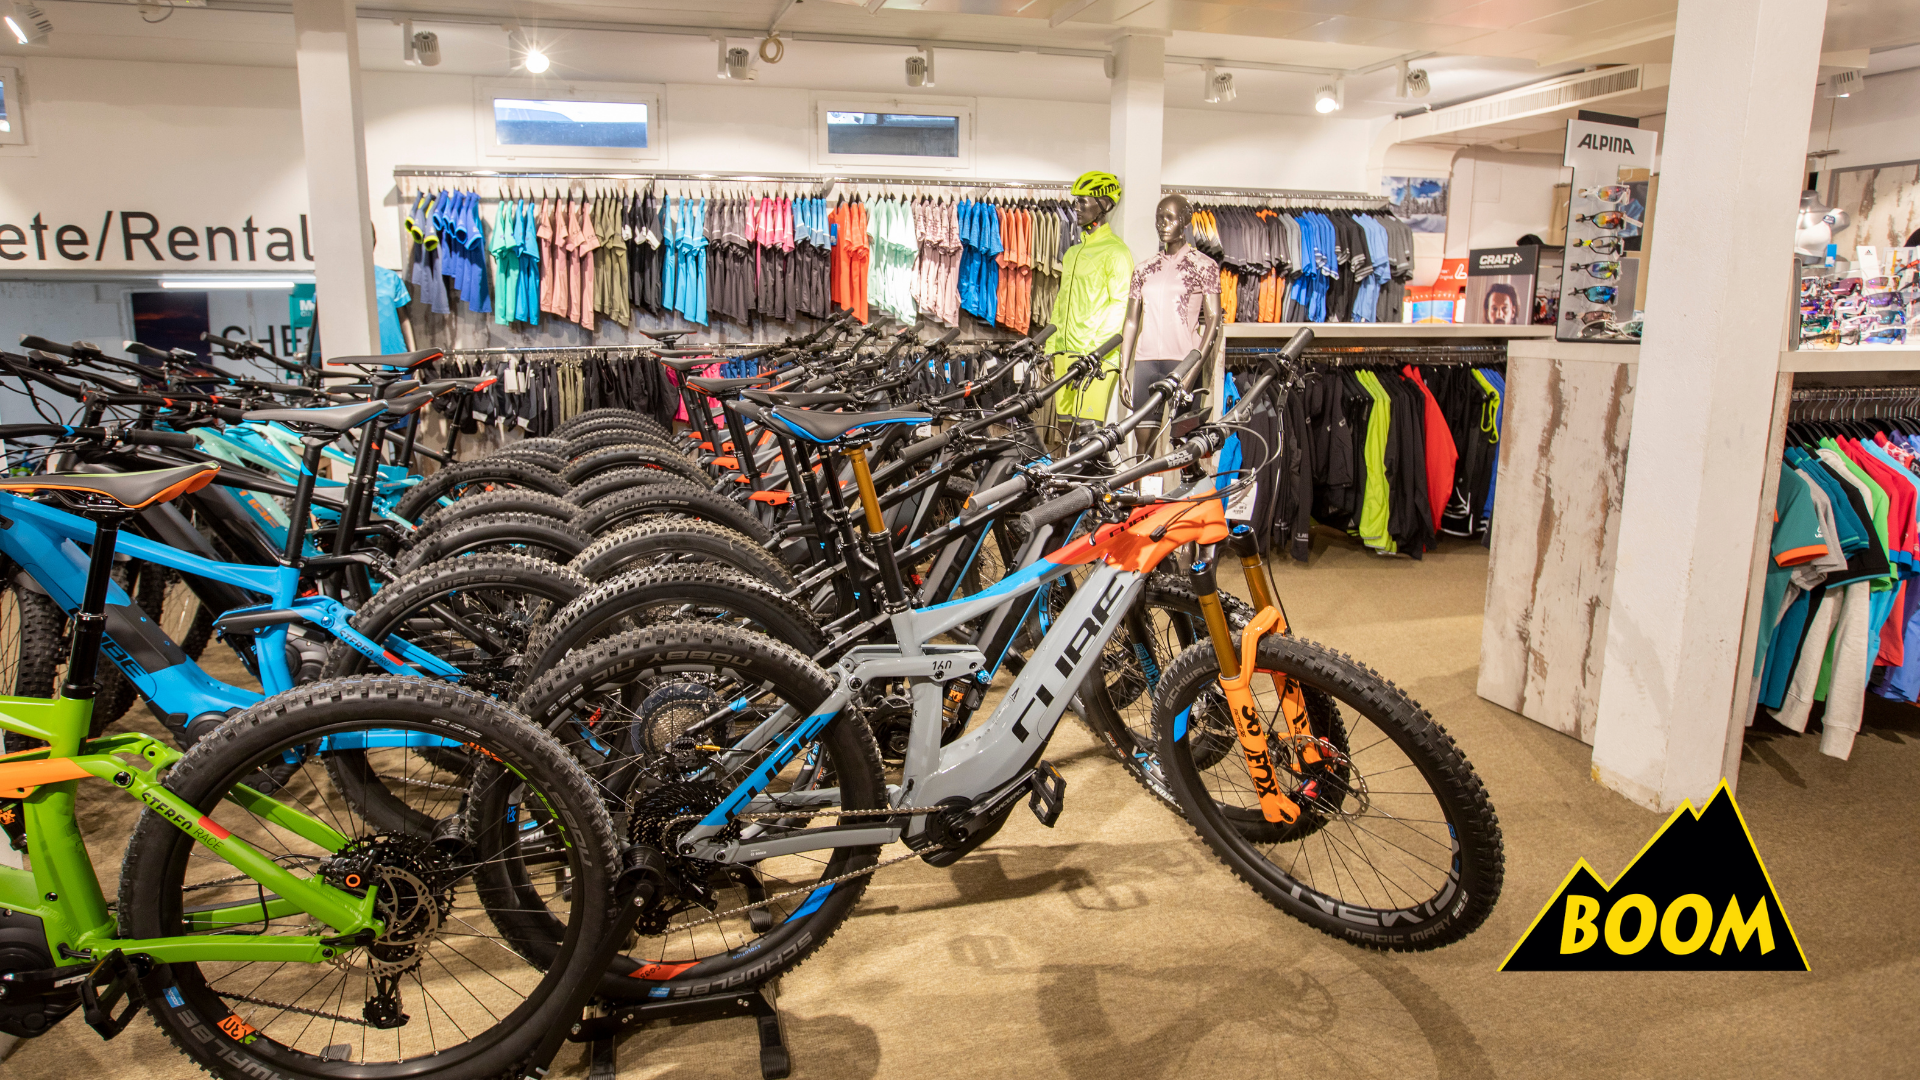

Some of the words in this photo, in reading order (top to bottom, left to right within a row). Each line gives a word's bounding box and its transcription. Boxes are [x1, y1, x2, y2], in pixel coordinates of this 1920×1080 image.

[1577, 133, 1635, 155] ALPINA
[1479, 253, 1514, 265] CRAFT
[222, 325, 312, 357] CHE
[604, 500, 690, 520] SCHWALBE
[391, 574, 517, 616] SCHWALBE
[1165, 662, 1221, 710] SCHWAL
[1245, 748, 1278, 798] FOX
[141, 792, 193, 830] STEREO
[192, 827, 225, 851] RACE
[1344, 928, 1404, 943] MAGIC
[1410, 914, 1451, 942] MARY
[673, 932, 813, 997] SCHWALBE
